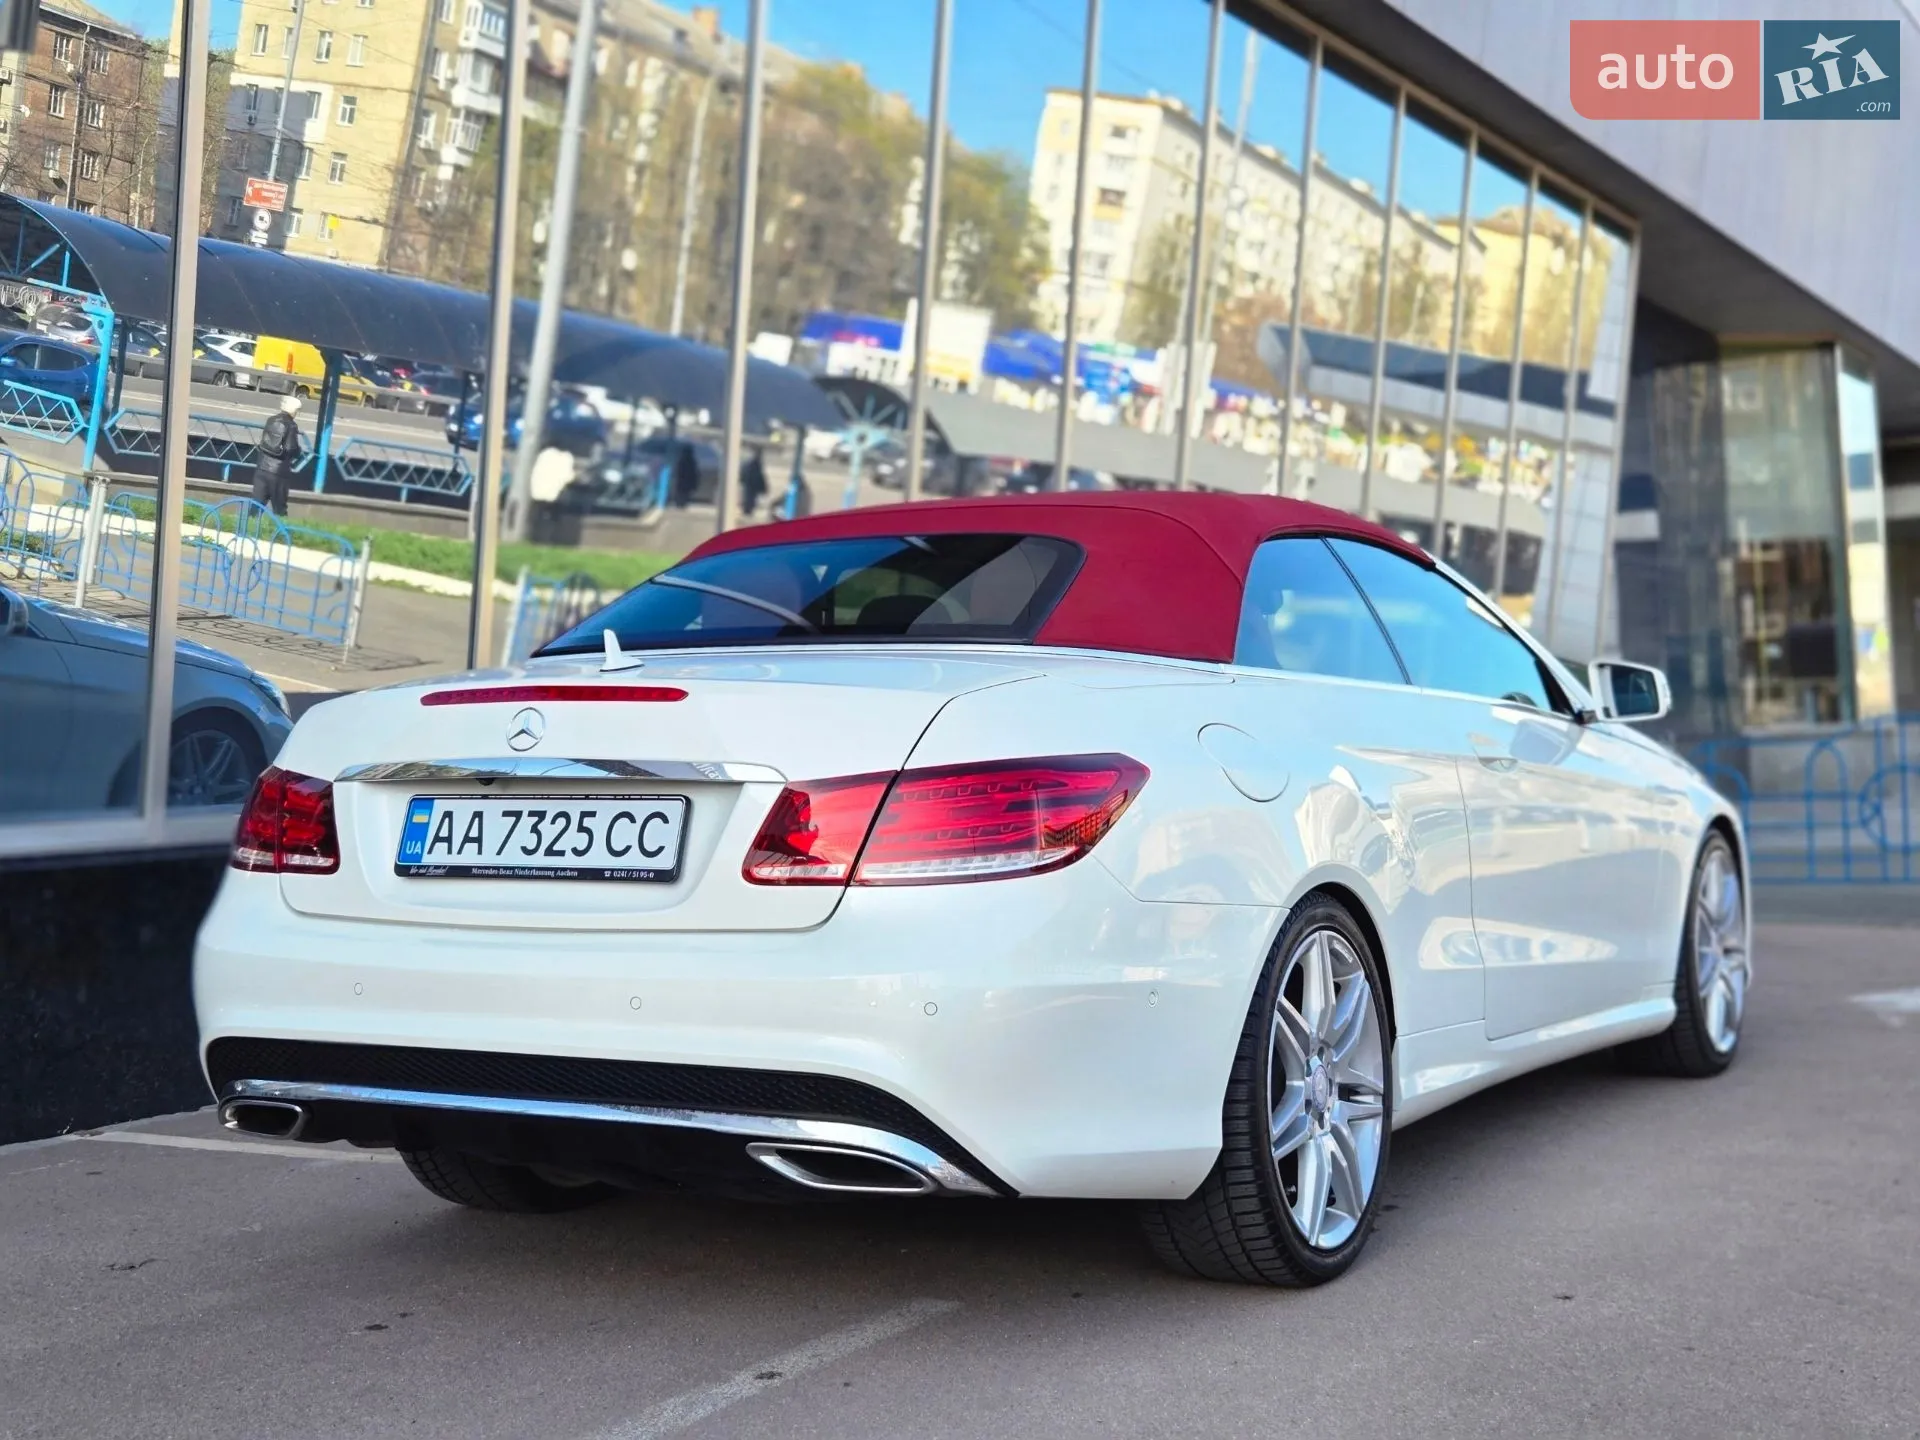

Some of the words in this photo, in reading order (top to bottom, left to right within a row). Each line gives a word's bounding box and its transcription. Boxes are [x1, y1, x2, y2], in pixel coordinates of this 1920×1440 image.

[406, 840, 422, 855] UA
[427, 810, 484, 855] AA
[495, 810, 597, 857] 7325
[605, 811, 669, 858] CC
